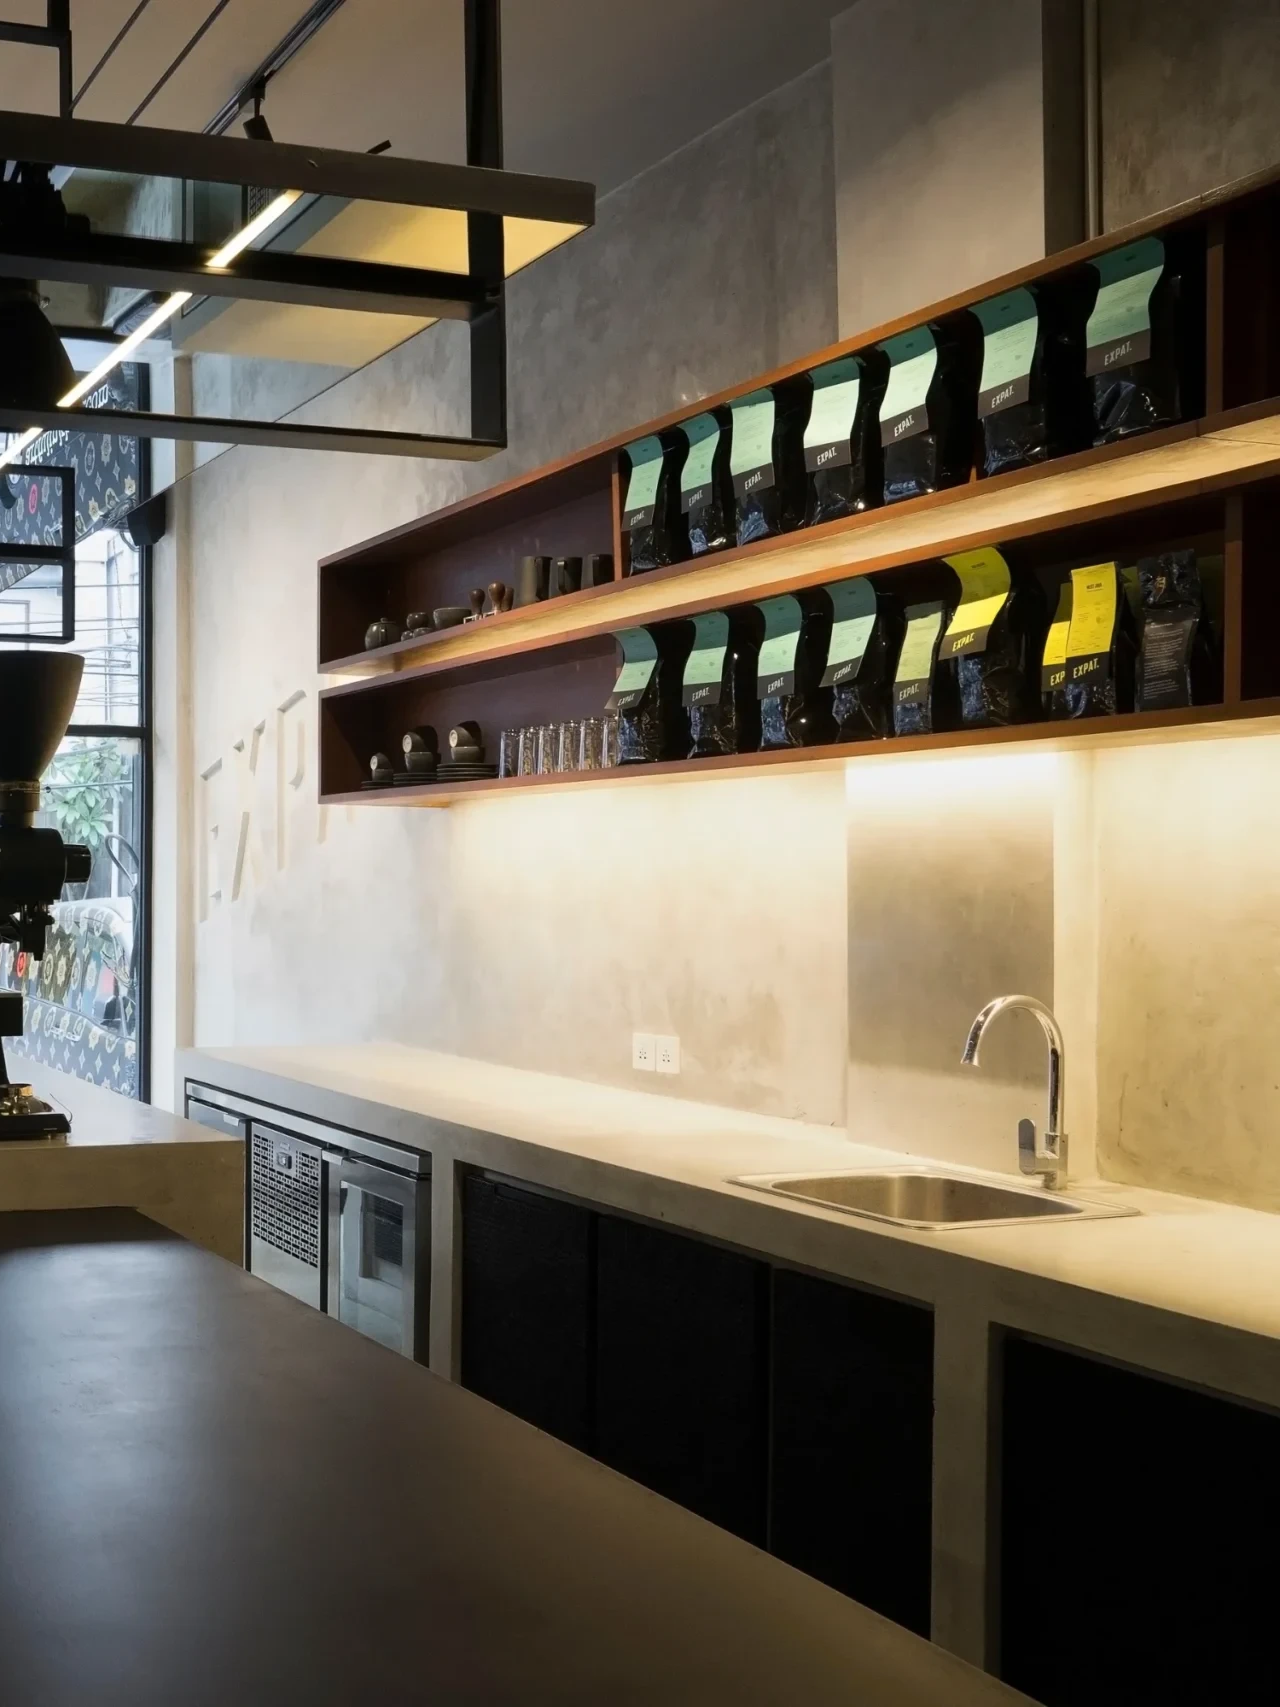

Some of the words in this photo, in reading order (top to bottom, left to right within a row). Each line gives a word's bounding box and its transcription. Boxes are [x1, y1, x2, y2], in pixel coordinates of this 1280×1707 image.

[1103, 340, 1133, 367] EXPAT.
[991, 385, 1014, 409] EXPAT.
[893, 414, 915, 437] EXPAT.
[816, 446, 838, 466] EXPAT.
[744, 471, 763, 491] EXPAT.
[688, 489, 704, 507] EXPAT.
[951, 632, 975, 652] EXPAT.
[1049, 670, 1066, 686] EXP
[1072, 657, 1100, 679] EXPAT.
[691, 686, 710, 702] EXPAT.
[767, 677, 785, 694] EXPAT.
[899, 683, 919, 701] EXPAT.
